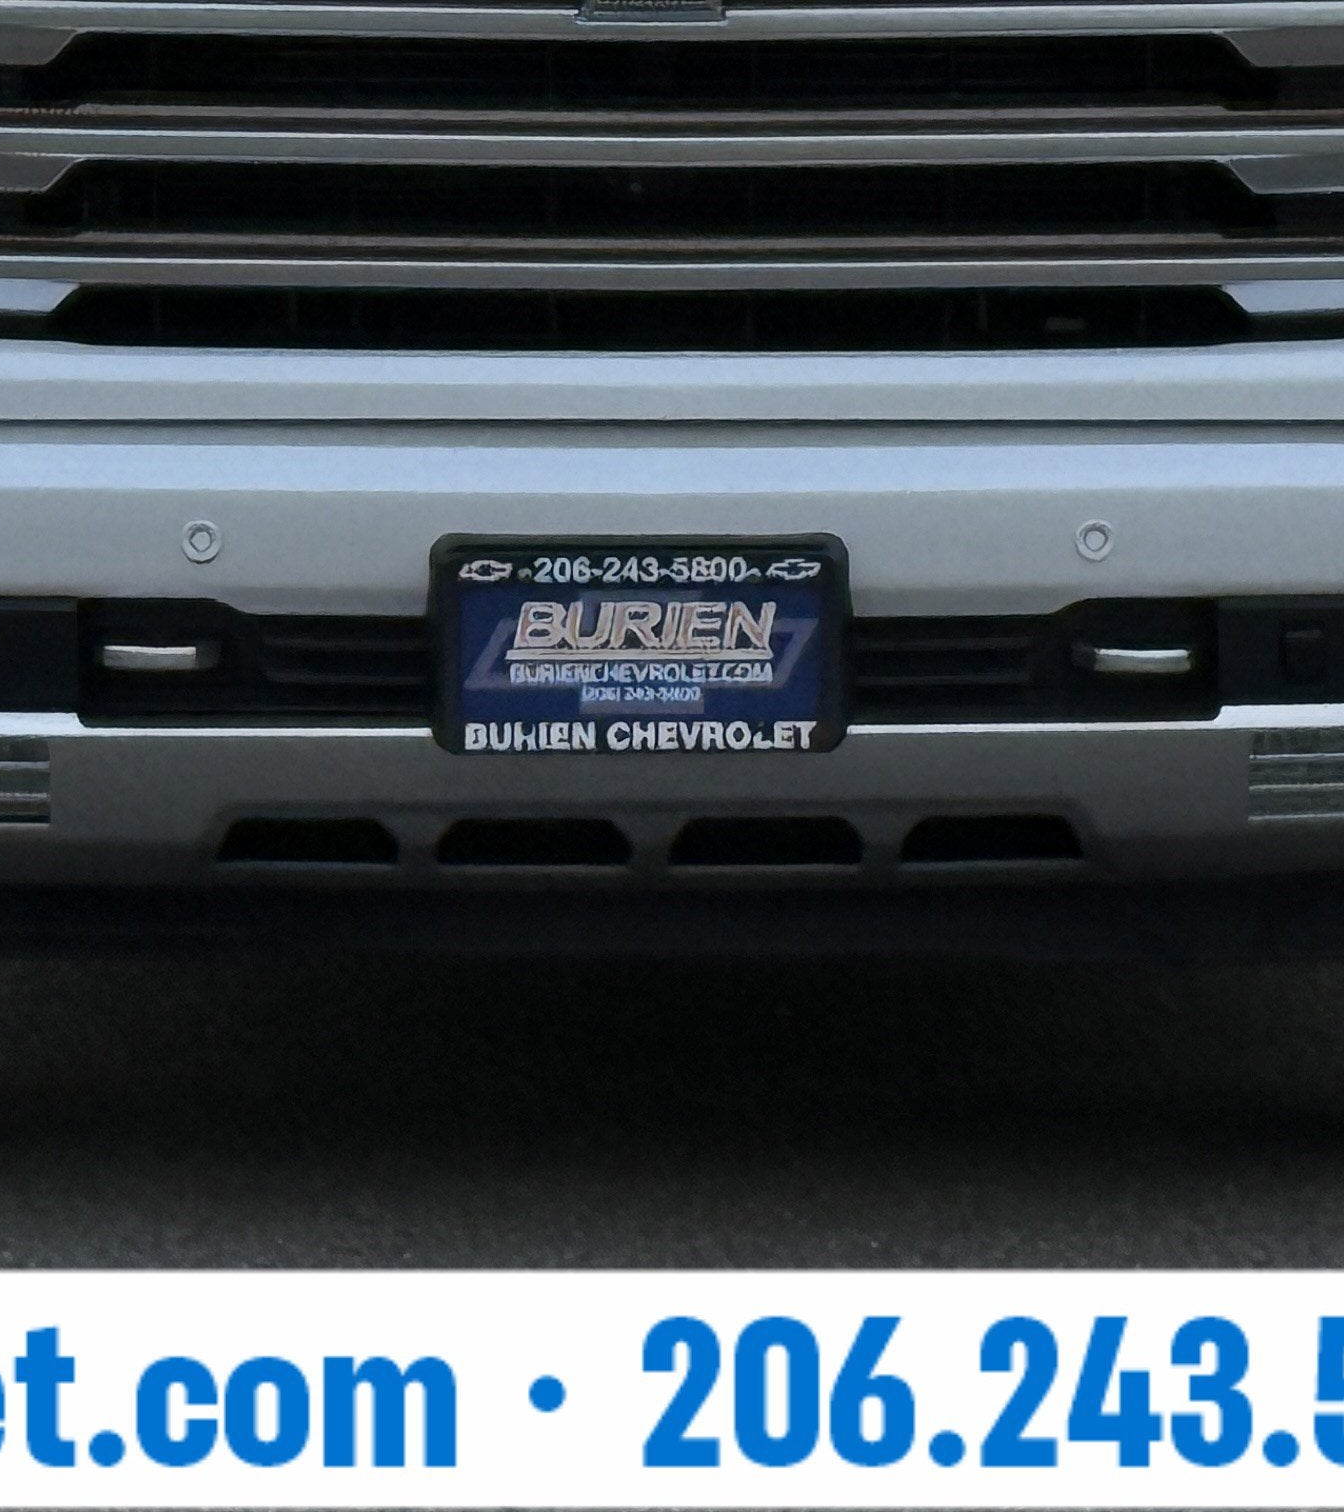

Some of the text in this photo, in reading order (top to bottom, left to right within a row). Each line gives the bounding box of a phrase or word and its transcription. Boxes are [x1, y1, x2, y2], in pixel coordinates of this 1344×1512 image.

[513, 601, 778, 649] BURIEN
[464, 720, 817, 751] BURIEN CHEVROLET
